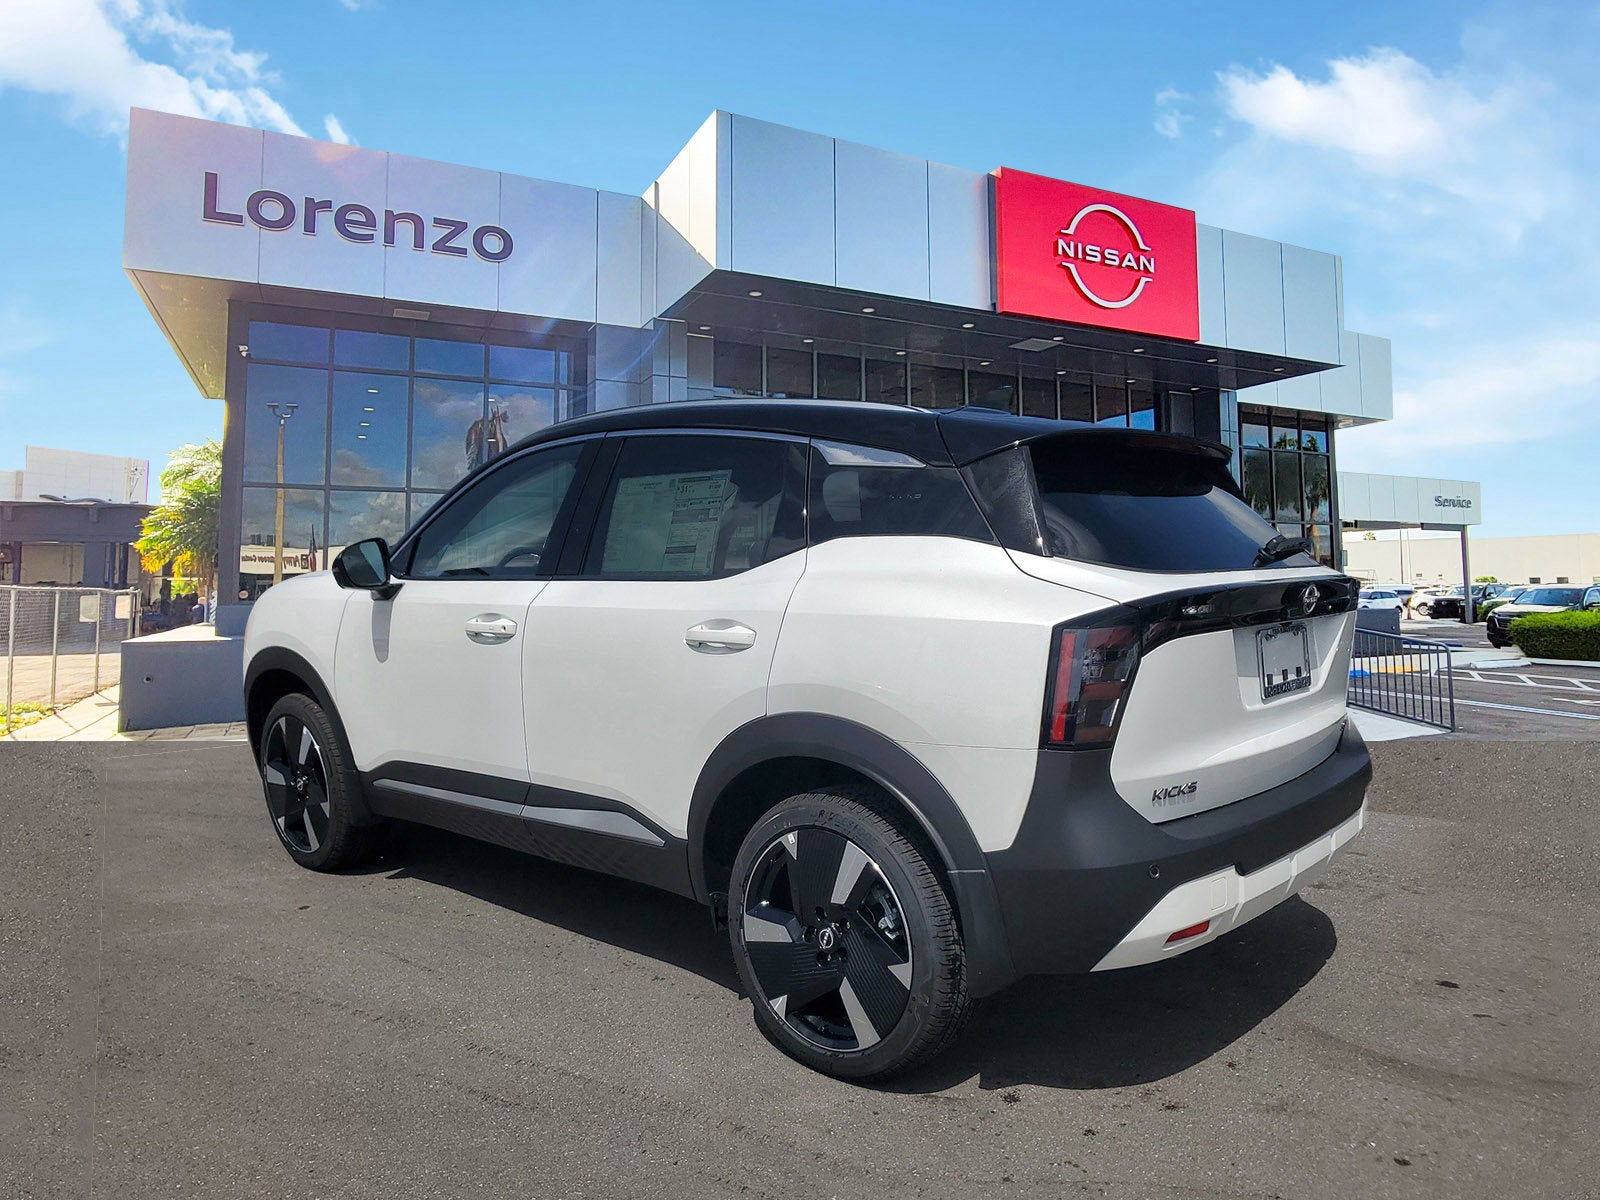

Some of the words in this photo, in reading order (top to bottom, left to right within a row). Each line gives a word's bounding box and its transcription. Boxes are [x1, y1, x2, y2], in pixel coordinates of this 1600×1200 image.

[202, 171, 515, 262] Lorenzo
[1057, 238, 1156, 273] NISSAN
[1434, 495, 1472, 509] Service
[1151, 780, 1198, 802] KICKS
